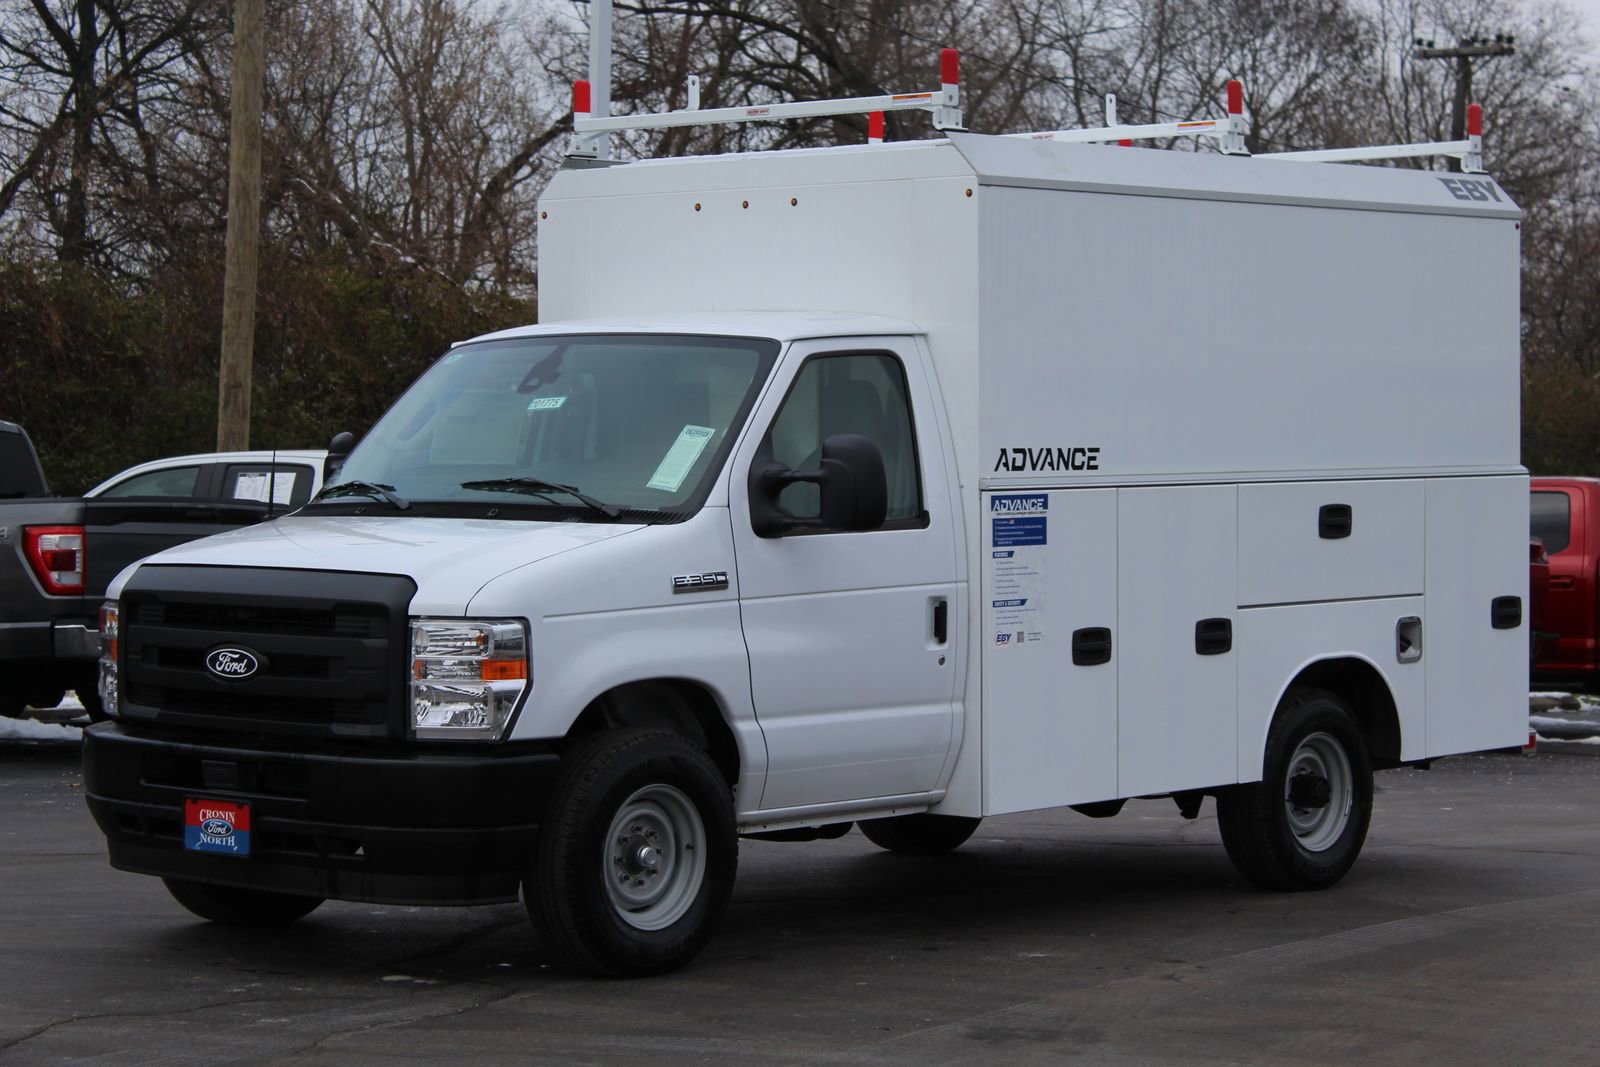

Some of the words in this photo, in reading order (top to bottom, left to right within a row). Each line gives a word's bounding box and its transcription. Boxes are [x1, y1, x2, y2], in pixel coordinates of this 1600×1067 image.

[1436, 177, 1503, 202] EBY
[994, 447, 1100, 472] ADVANCE
[993, 498, 1045, 512] ADVANCE
[996, 633, 1012, 643] EBY
[215, 652, 248, 673] Ford
[199, 808, 236, 825] CRONIN
[207, 820, 228, 835] Ford
[200, 832, 236, 847] NORTH
